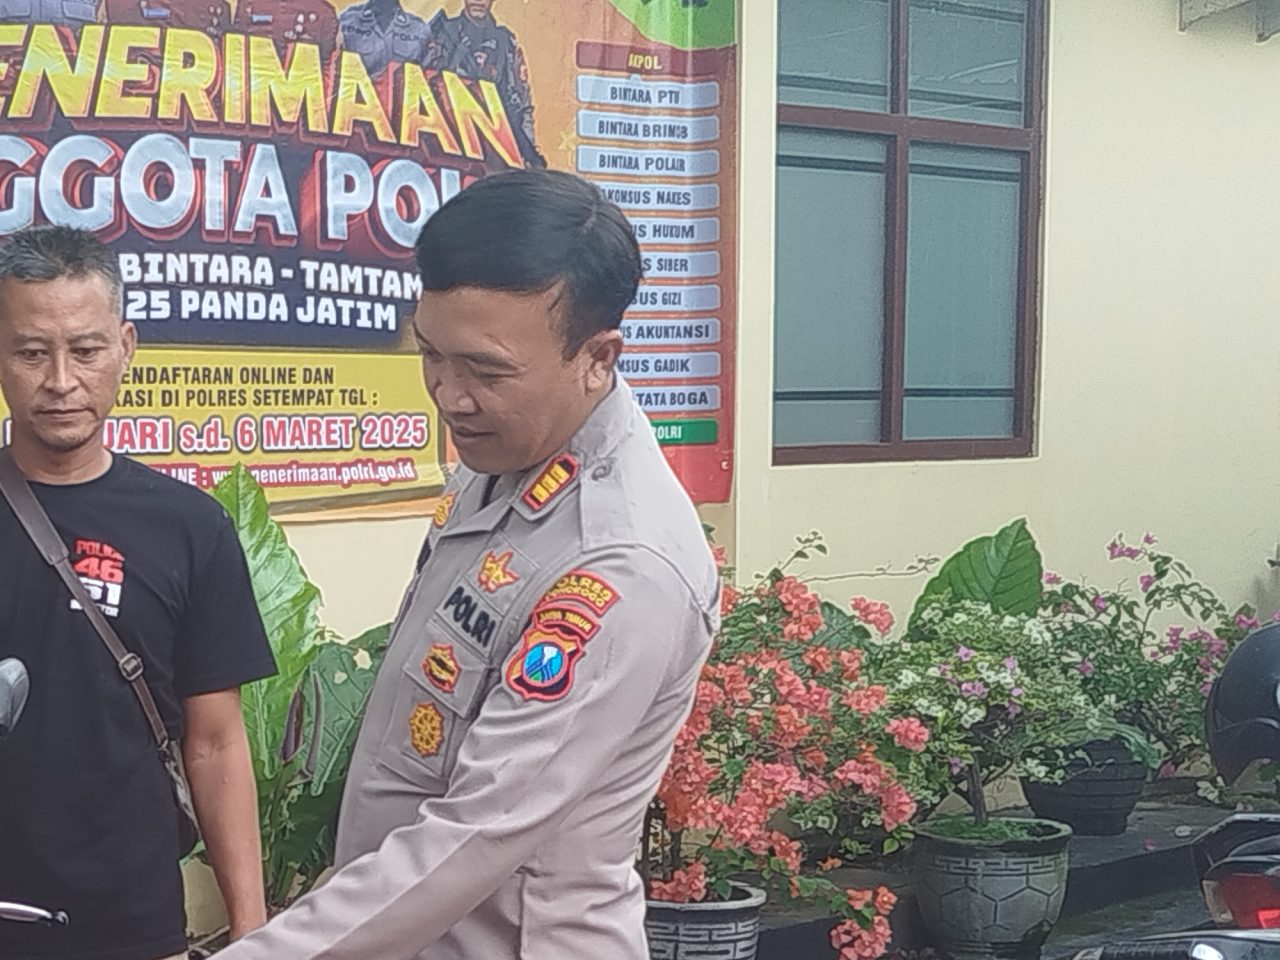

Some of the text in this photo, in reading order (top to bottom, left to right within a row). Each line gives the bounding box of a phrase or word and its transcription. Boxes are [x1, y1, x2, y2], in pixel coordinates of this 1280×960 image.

[610, 86, 652, 103] BINTARA
[598, 120, 639, 137] BINTARA
[598, 154, 640, 170] BINTARA
[652, 224, 695, 238] HUKUM
[119, 253, 273, 286] BINTARA
[300, 260, 422, 300] TAMTAM
[661, 291, 682, 306] GIZI
[125, 289, 398, 331] 25 PANDA JATIM
[653, 358, 690, 373] GADIK
[121, 366, 335, 386] ENDAFTARAN ONLINE DAN
[161, 389, 179, 407] DI
[186, 388, 247, 407] POLRES
[253, 388, 333, 406] SETEMPAT
[636, 391, 709, 406] TATA BOGA
[180, 418, 230, 451] s.d.
[237, 416, 256, 449] 6
[263, 416, 355, 450] MARET
[361, 416, 428, 448] 2025
[73, 556, 125, 584] 46
[442, 585, 496, 648] POLRI
